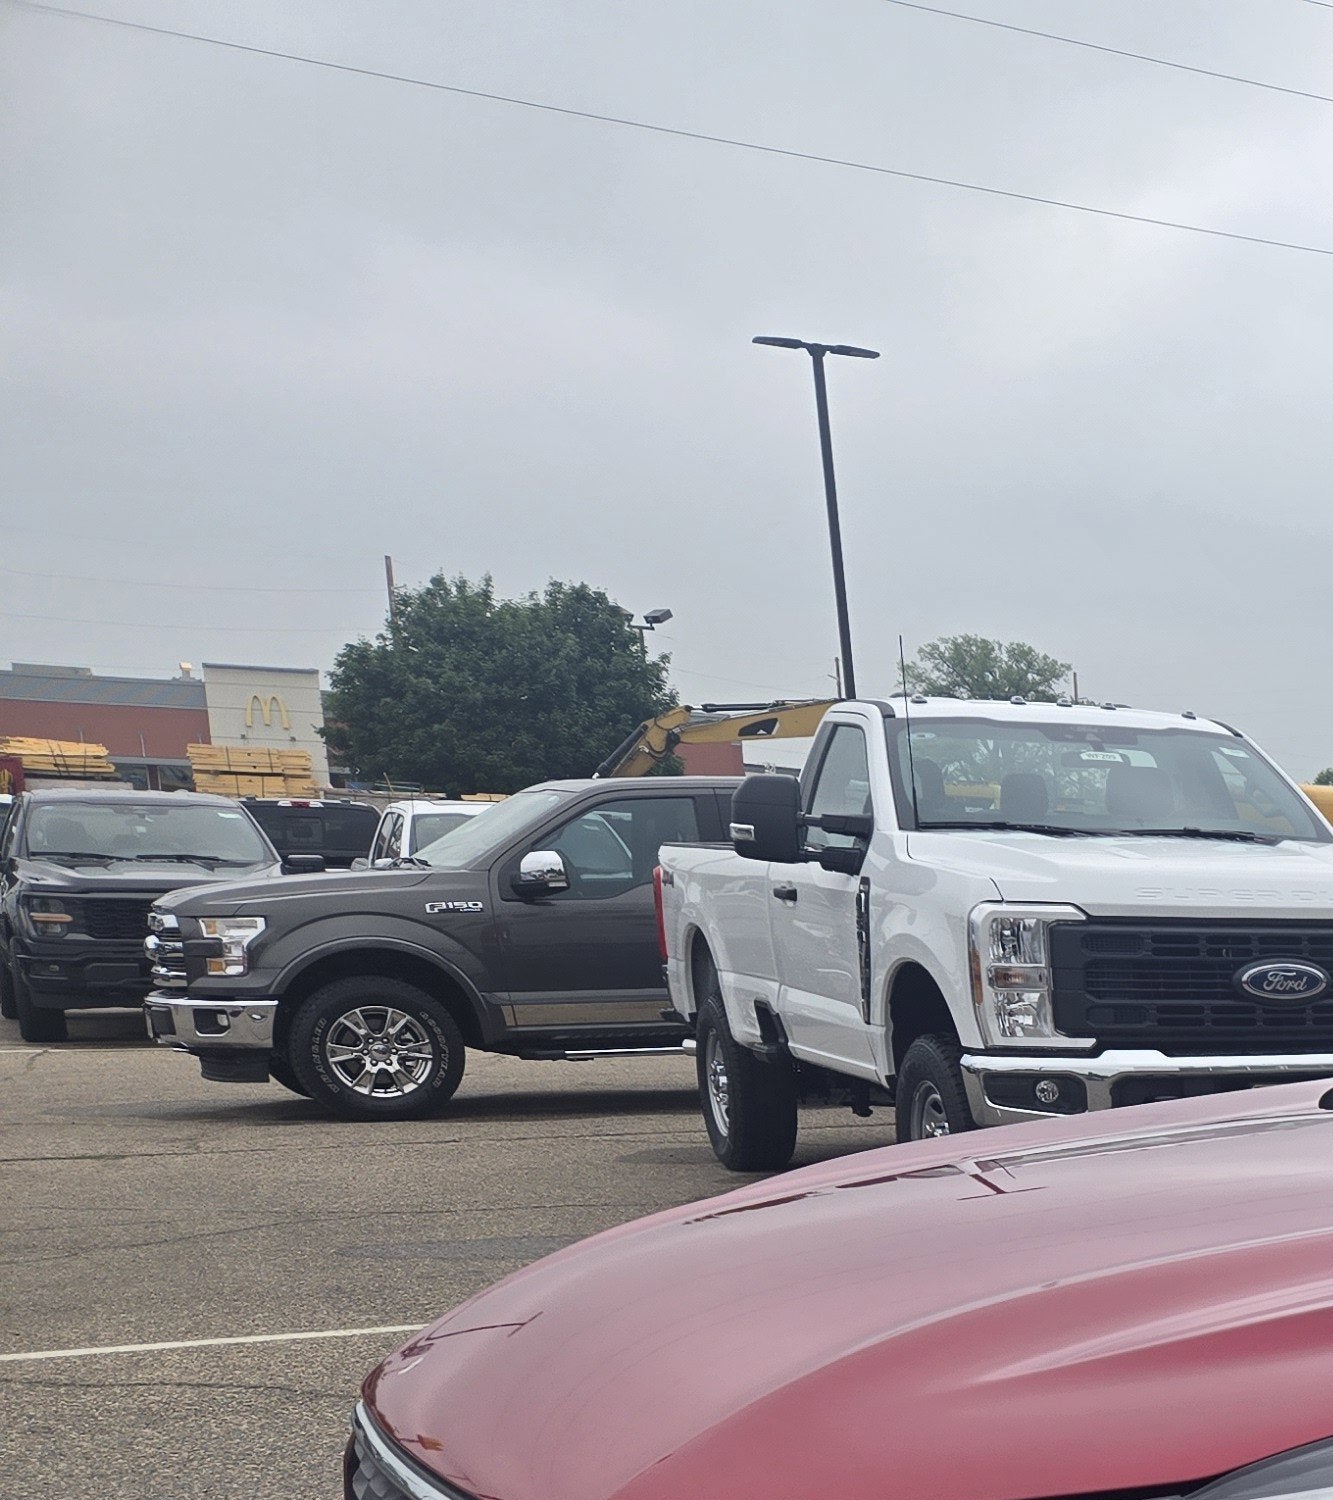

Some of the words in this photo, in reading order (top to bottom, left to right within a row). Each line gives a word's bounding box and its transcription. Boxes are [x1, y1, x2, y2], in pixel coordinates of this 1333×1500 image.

[1134, 887, 1283, 900] SUPER
[1263, 971, 1307, 991] Ford
[419, 1011, 450, 1088] GOODYEAR
